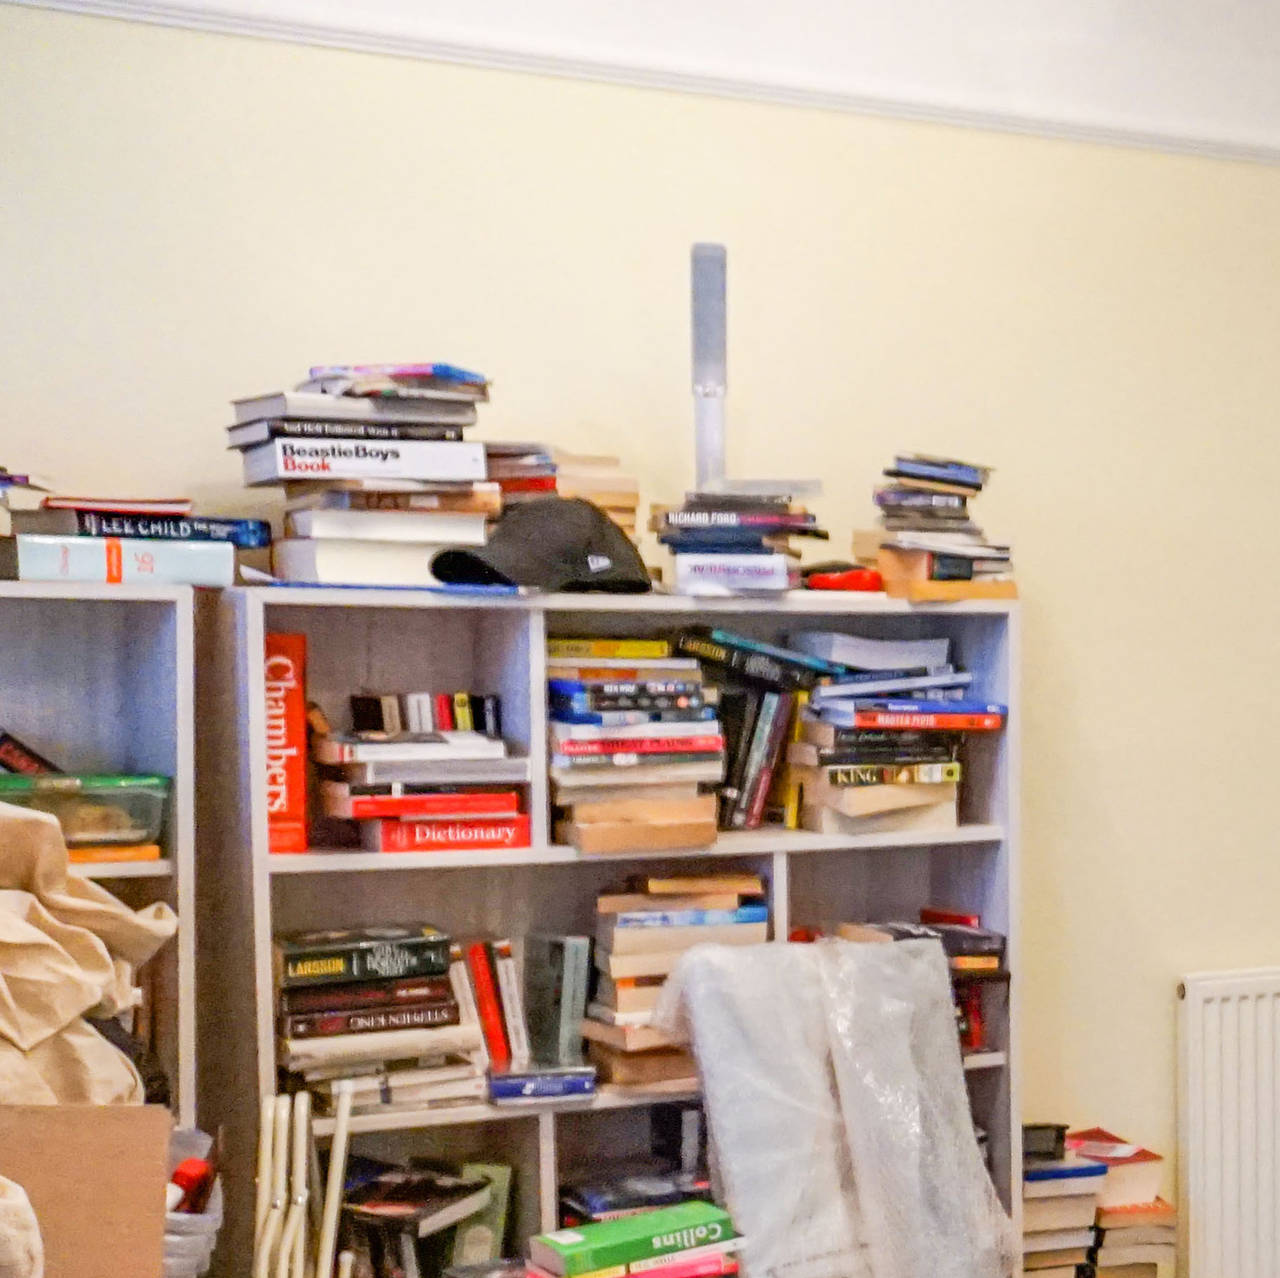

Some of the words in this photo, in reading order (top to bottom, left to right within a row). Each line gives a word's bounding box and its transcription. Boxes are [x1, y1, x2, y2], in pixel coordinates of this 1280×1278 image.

[283, 457, 331, 473] Book
[668, 512, 709, 525] RICHARD
[711, 512, 737, 524] FORD
[102, 519, 134, 534] LEE
[138, 521, 191, 538] CHILD
[265, 655, 297, 813] Chambers
[836, 769, 878, 784] KING
[414, 823, 517, 845] Dictionary
[651, 1222, 723, 1249] Collins
